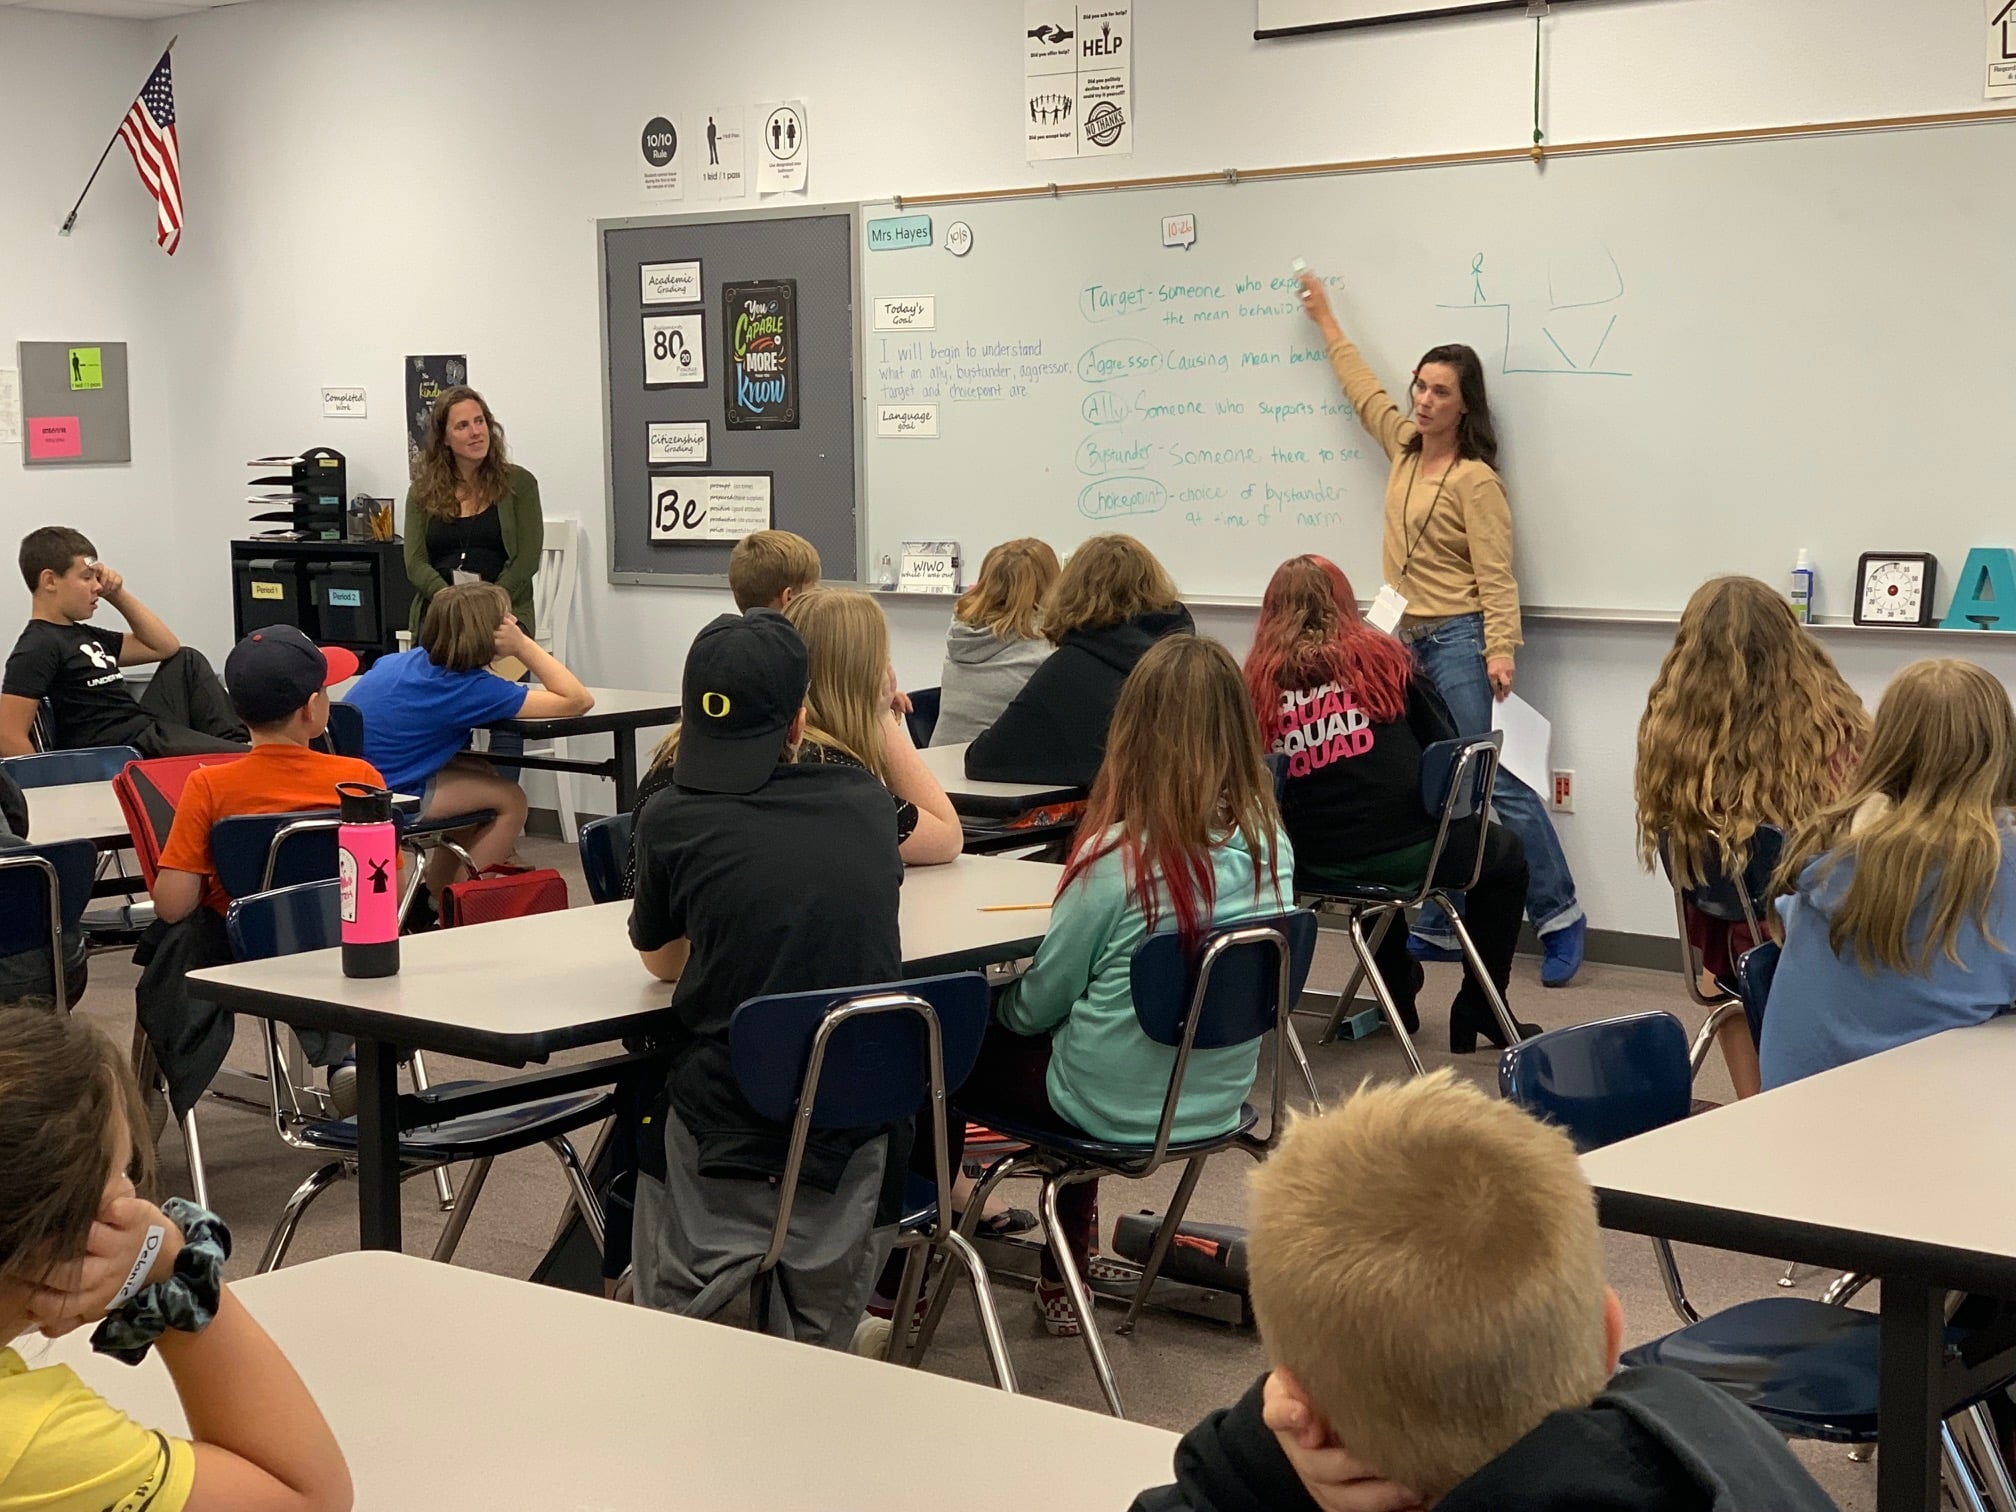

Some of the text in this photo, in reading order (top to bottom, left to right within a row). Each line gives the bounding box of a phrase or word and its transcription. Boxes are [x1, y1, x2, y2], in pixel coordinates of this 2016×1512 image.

[1083, 36, 1122, 57] HELP
[1085, 111, 1124, 136] NO THANKS
[647, 133, 672, 147] 10/10
[653, 150, 668, 159] Rule
[707, 172, 717, 180] kid
[727, 172, 740, 180] pass
[872, 226, 928, 242] Mrs Hayes
[648, 273, 694, 286] Academic
[657, 284, 686, 294] Grading
[1084, 284, 1145, 315] Target
[1236, 275, 1262, 294] who
[744, 299, 768, 321] You
[884, 303, 924, 317] Today's
[1162, 312, 1185, 324] the
[1193, 310, 1229, 322] mean
[893, 315, 912, 325] Goal
[654, 330, 684, 360] 80
[880, 338, 1042, 365] I will begin to understand
[746, 352, 778, 372] MORE
[879, 367, 904, 381] what
[910, 368, 922, 379] an
[736, 362, 785, 414] know
[880, 385, 915, 401] target
[922, 384, 941, 398] and
[325, 392, 364, 405] Completed
[1216, 398, 1244, 415] who
[882, 410, 932, 423] Language
[651, 433, 704, 446] Citizenship
[664, 443, 694, 454] Grading
[1271, 446, 1310, 464] there
[1319, 448, 1334, 464] to
[1340, 448, 1365, 461] see
[1180, 487, 1228, 502] choice
[1240, 483, 1256, 499] of
[1265, 478, 1348, 512] bystander
[656, 489, 707, 532] Be
[914, 560, 944, 572] WIWO
[256, 585, 274, 594] Period
[333, 592, 351, 601] Period
[1938, 548, 2016, 630] A
[702, 692, 730, 718] O
[1287, 728, 1374, 778] QUAD
